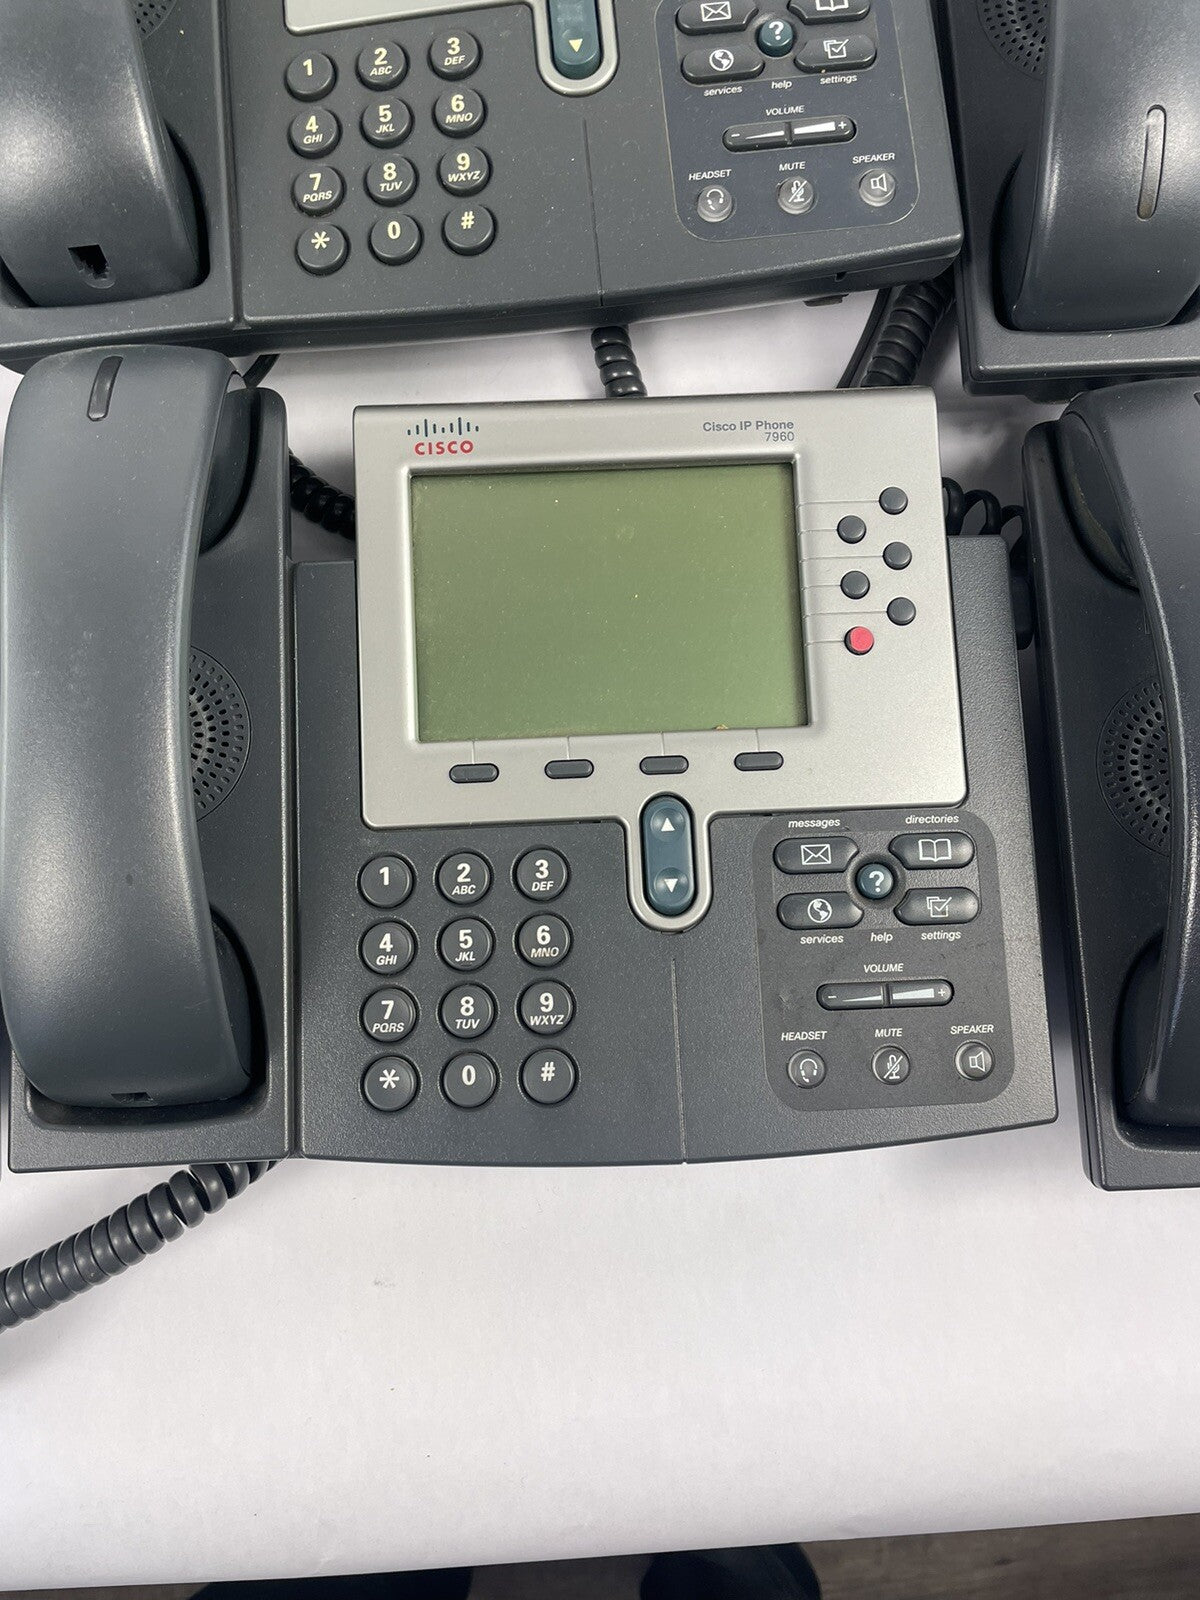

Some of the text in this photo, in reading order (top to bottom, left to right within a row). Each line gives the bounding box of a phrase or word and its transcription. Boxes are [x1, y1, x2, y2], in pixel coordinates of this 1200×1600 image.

[447, 37, 460, 55] 3
[374, 47, 387, 65] 2
[444, 55, 465, 66] DEF
[303, 59, 313, 76] 1
[370, 66, 393, 76] ABC
[771, 80, 792, 89] help
[820, 74, 857, 85] settings
[704, 85, 742, 97] services
[451, 94, 464, 112] 6
[379, 105, 392, 122] 5
[766, 105, 804, 116] VOLUME
[445, 112, 473, 123] MNO
[306, 116, 318, 133] 4
[376, 123, 395, 133] JKL
[303, 133, 323, 144] GHI
[457, 153, 470, 170] 9
[852, 153, 895, 164] SPEAKER
[383, 163, 396, 180] 8
[779, 162, 806, 172] MUTE
[448, 171, 480, 182] WXYZ
[688, 169, 731, 180] HEADSET
[309, 173, 322, 190] 7
[380, 181, 402, 192] TUV
[303, 191, 332, 202] PQRS
[461, 211, 474, 229] #
[387, 221, 400, 239] 0
[703, 420, 794, 432] Cisco IP Phone
[764, 432, 794, 442] 7960
[415, 440, 474, 455] CISCO
[788, 818, 840, 829] messages
[905, 815, 959, 824] directories
[456, 863, 471, 882] 2
[535, 859, 548, 878] 3
[379, 867, 389, 885] 1
[452, 885, 476, 895] ABC
[531, 881, 553, 891] DEF
[459, 930, 473, 948] 5
[536, 925, 550, 944] 6
[800, 933, 844, 944] services
[870, 932, 893, 943] help
[921, 930, 961, 941] settings
[379, 933, 393, 952] 4
[455, 951, 476, 962] JKL
[530, 947, 559, 958] MNO
[376, 955, 397, 965] GHI
[863, 963, 904, 973] VOLUME
[460, 997, 474, 1016] 8
[540, 993, 553, 1012] 9
[381, 1000, 394, 1019] 7
[455, 1019, 480, 1029] TUV
[530, 1015, 564, 1025] WXYZ
[372, 1023, 404, 1033] PQRS
[875, 1028, 903, 1037] MUTE
[950, 1025, 994, 1034] SPEAKER
[781, 1031, 827, 1041] HEADSET
[462, 1065, 476, 1085] 0
